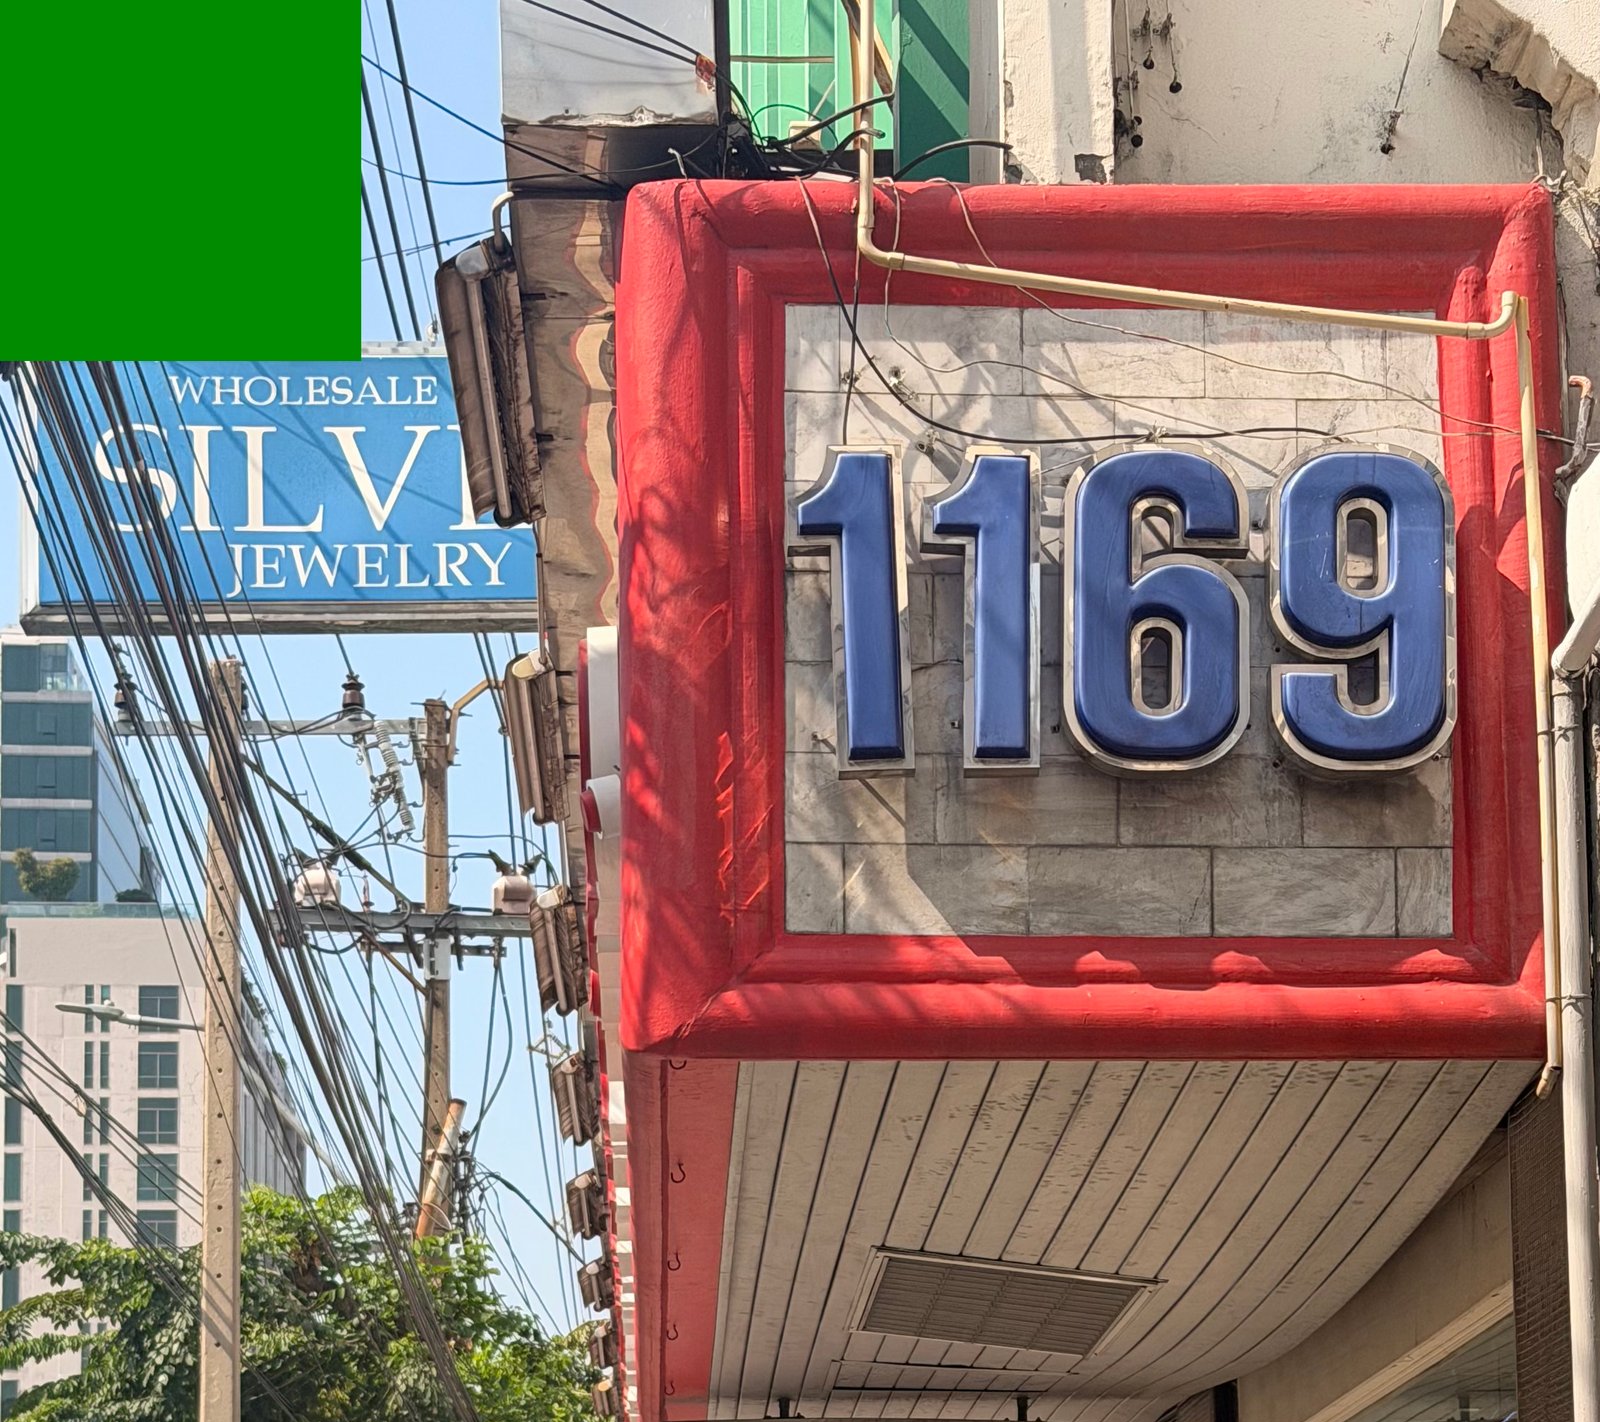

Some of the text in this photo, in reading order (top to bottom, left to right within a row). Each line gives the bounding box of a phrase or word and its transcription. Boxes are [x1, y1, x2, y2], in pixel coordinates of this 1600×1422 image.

[169, 375, 438, 406] WHOLESALE
[226, 541, 513, 598] JEWELRY
[787, 444, 1458, 778] 1169
